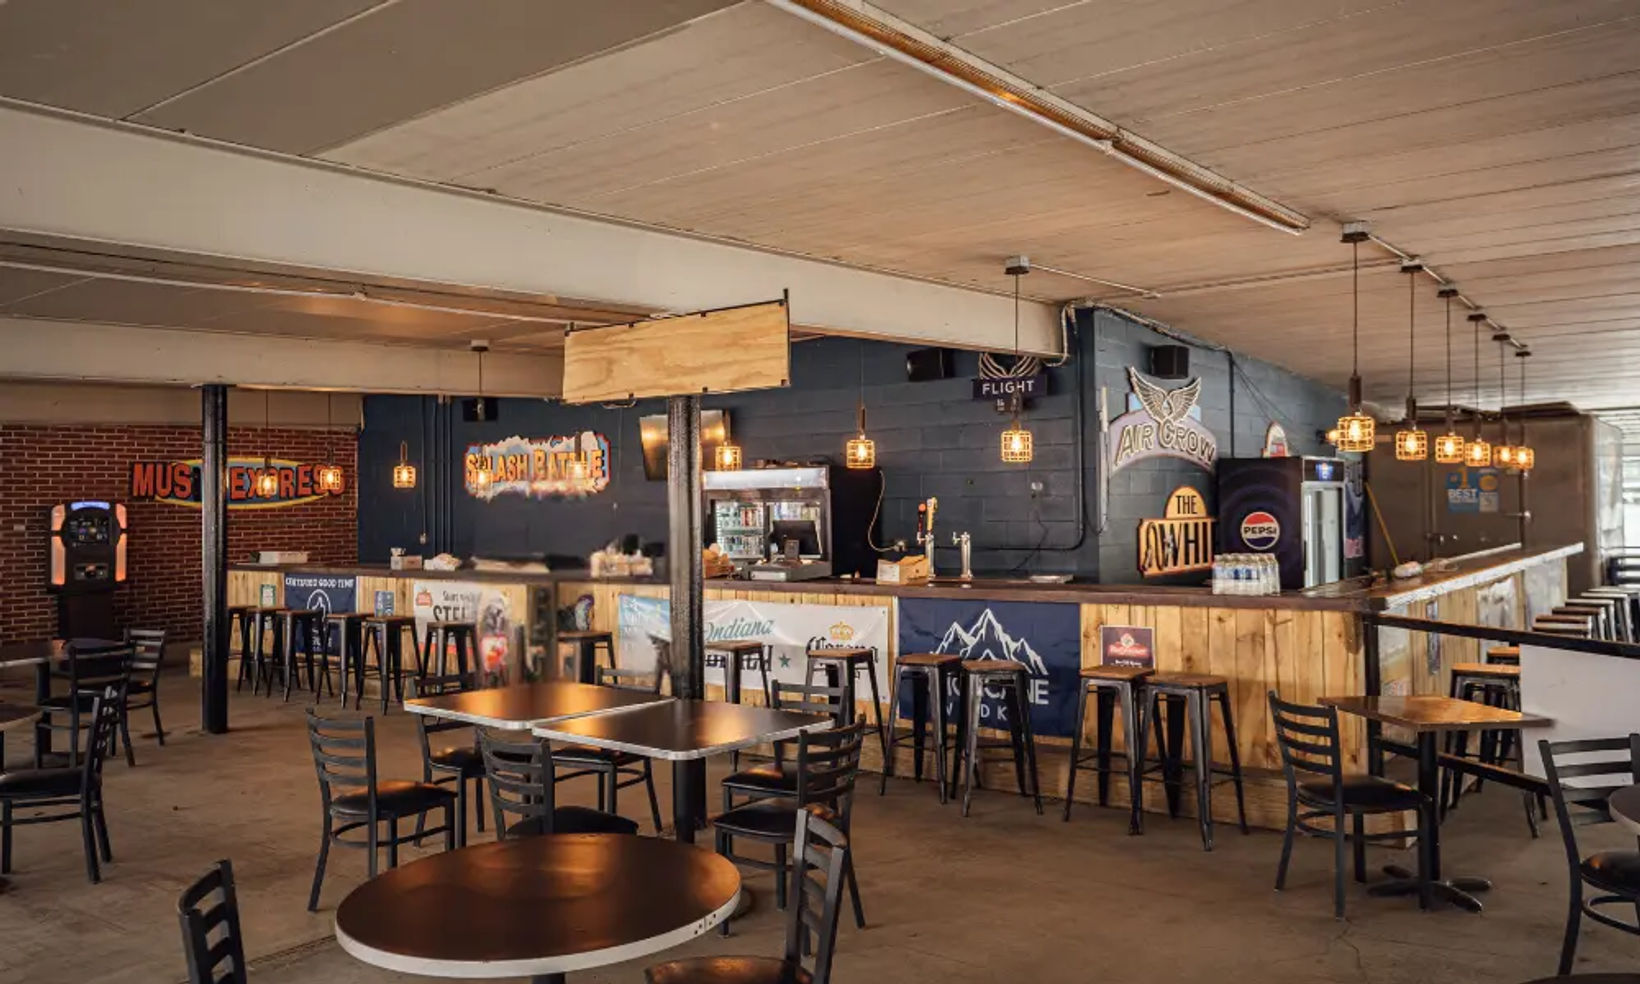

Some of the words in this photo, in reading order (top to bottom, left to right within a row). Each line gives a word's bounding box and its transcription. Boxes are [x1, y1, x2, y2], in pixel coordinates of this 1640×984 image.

[982, 380, 1035, 396] FLIGHT
[1114, 424, 1156, 470] AIR
[132, 462, 194, 499] MUS
[1175, 494, 1198, 515] THE
[1243, 525, 1278, 535] PEPSI
